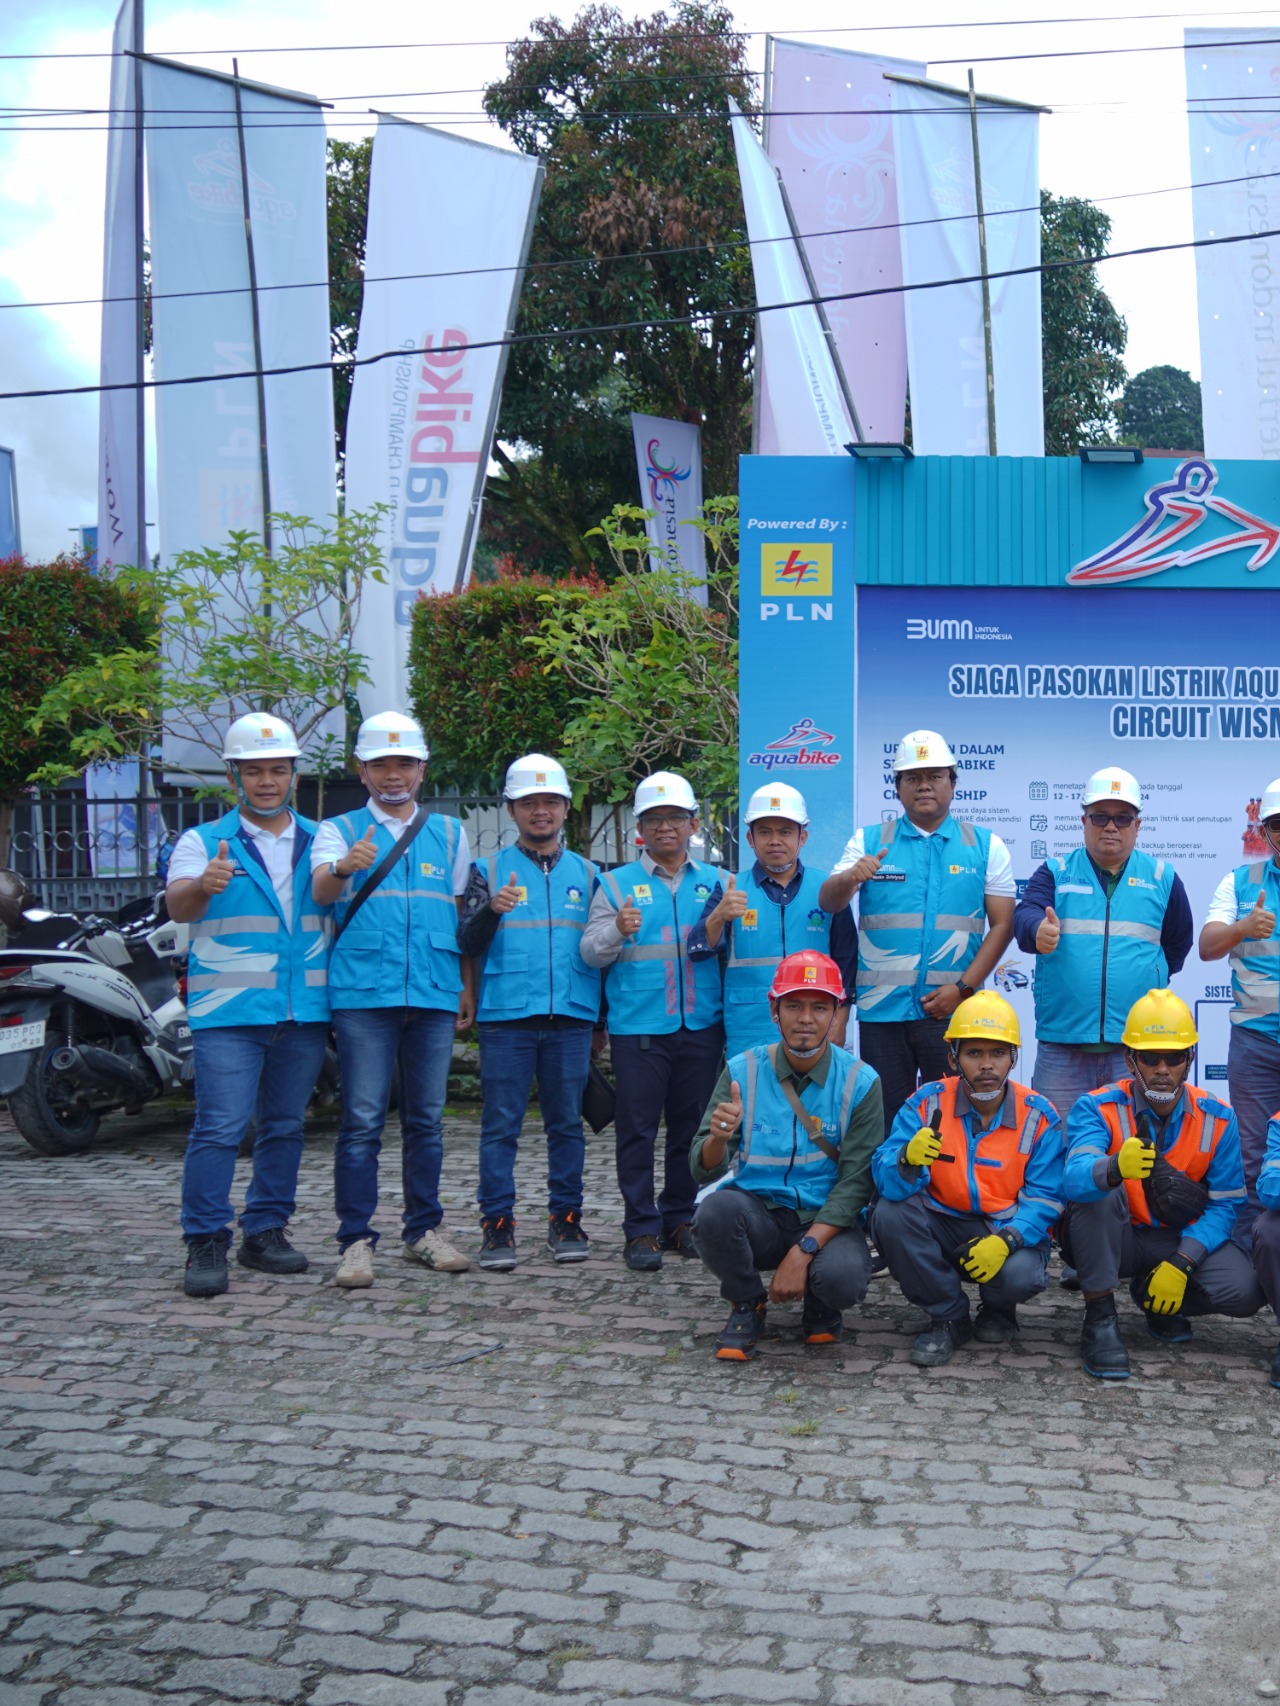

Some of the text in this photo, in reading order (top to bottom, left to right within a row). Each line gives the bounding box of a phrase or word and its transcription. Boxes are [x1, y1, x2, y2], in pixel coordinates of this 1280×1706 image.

[747, 518, 816, 530] Powered
[761, 603, 833, 621] PLN
[950, 665, 1020, 697] SIAGA
[1026, 667, 1134, 698] PASOKAN
[1141, 667, 1227, 698] LISTRIK
[1112, 705, 1212, 739] CIRCUIT
[960, 744, 1005, 755] DALAM
[749, 748, 840, 771] aquabike
[956, 760, 996, 770] ABIKE
[1053, 783, 1087, 791] menetapk
[1157, 783, 1183, 792] tanggal
[971, 807, 987, 815] daya
[959, 866, 977, 874] PLN
[1204, 985, 1232, 998] SISTE
[821, 1122, 837, 1132] PLN
